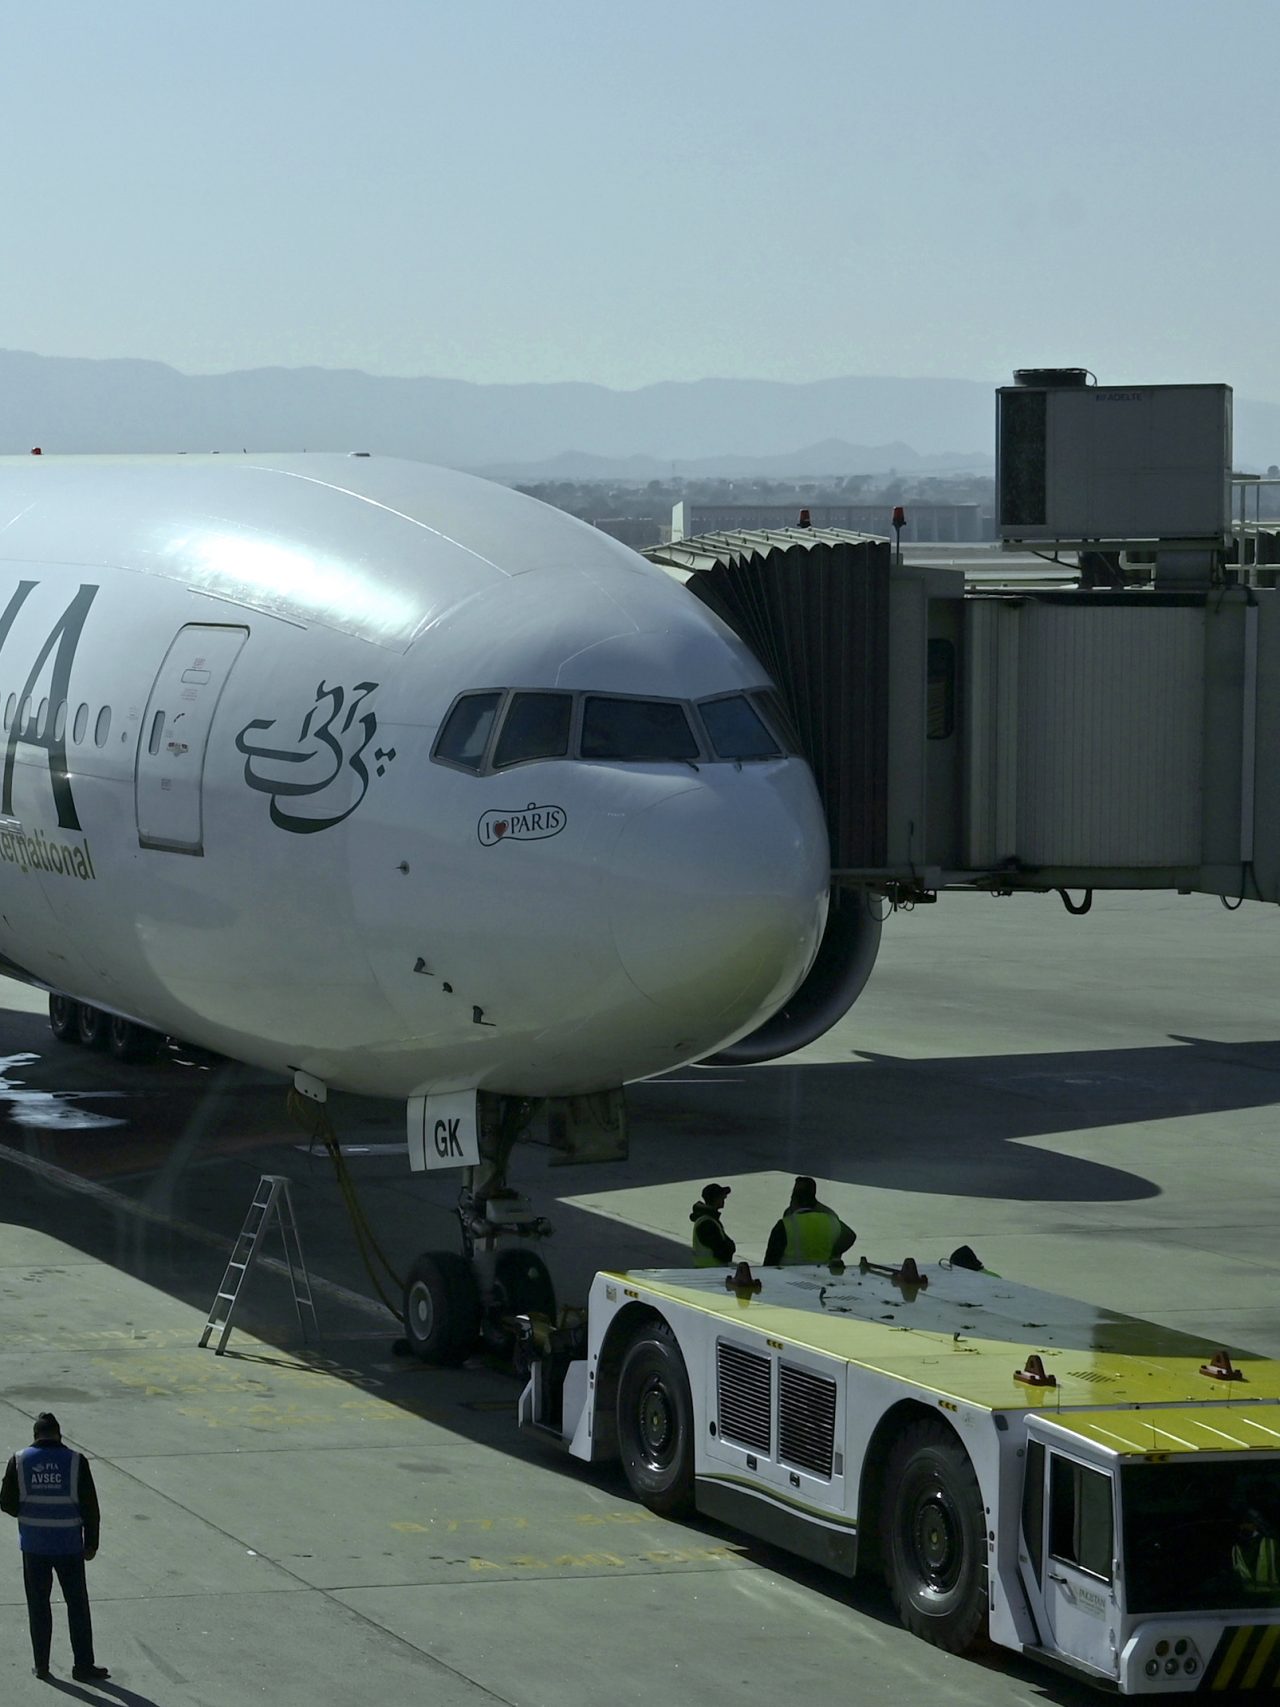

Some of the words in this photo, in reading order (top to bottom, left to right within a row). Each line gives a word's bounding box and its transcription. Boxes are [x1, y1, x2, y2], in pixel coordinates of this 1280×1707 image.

[486, 822, 490, 840] I
[511, 810, 560, 834] PARIS
[434, 1118, 464, 1158] GK
[32, 1473, 62, 1483] AVSEC
